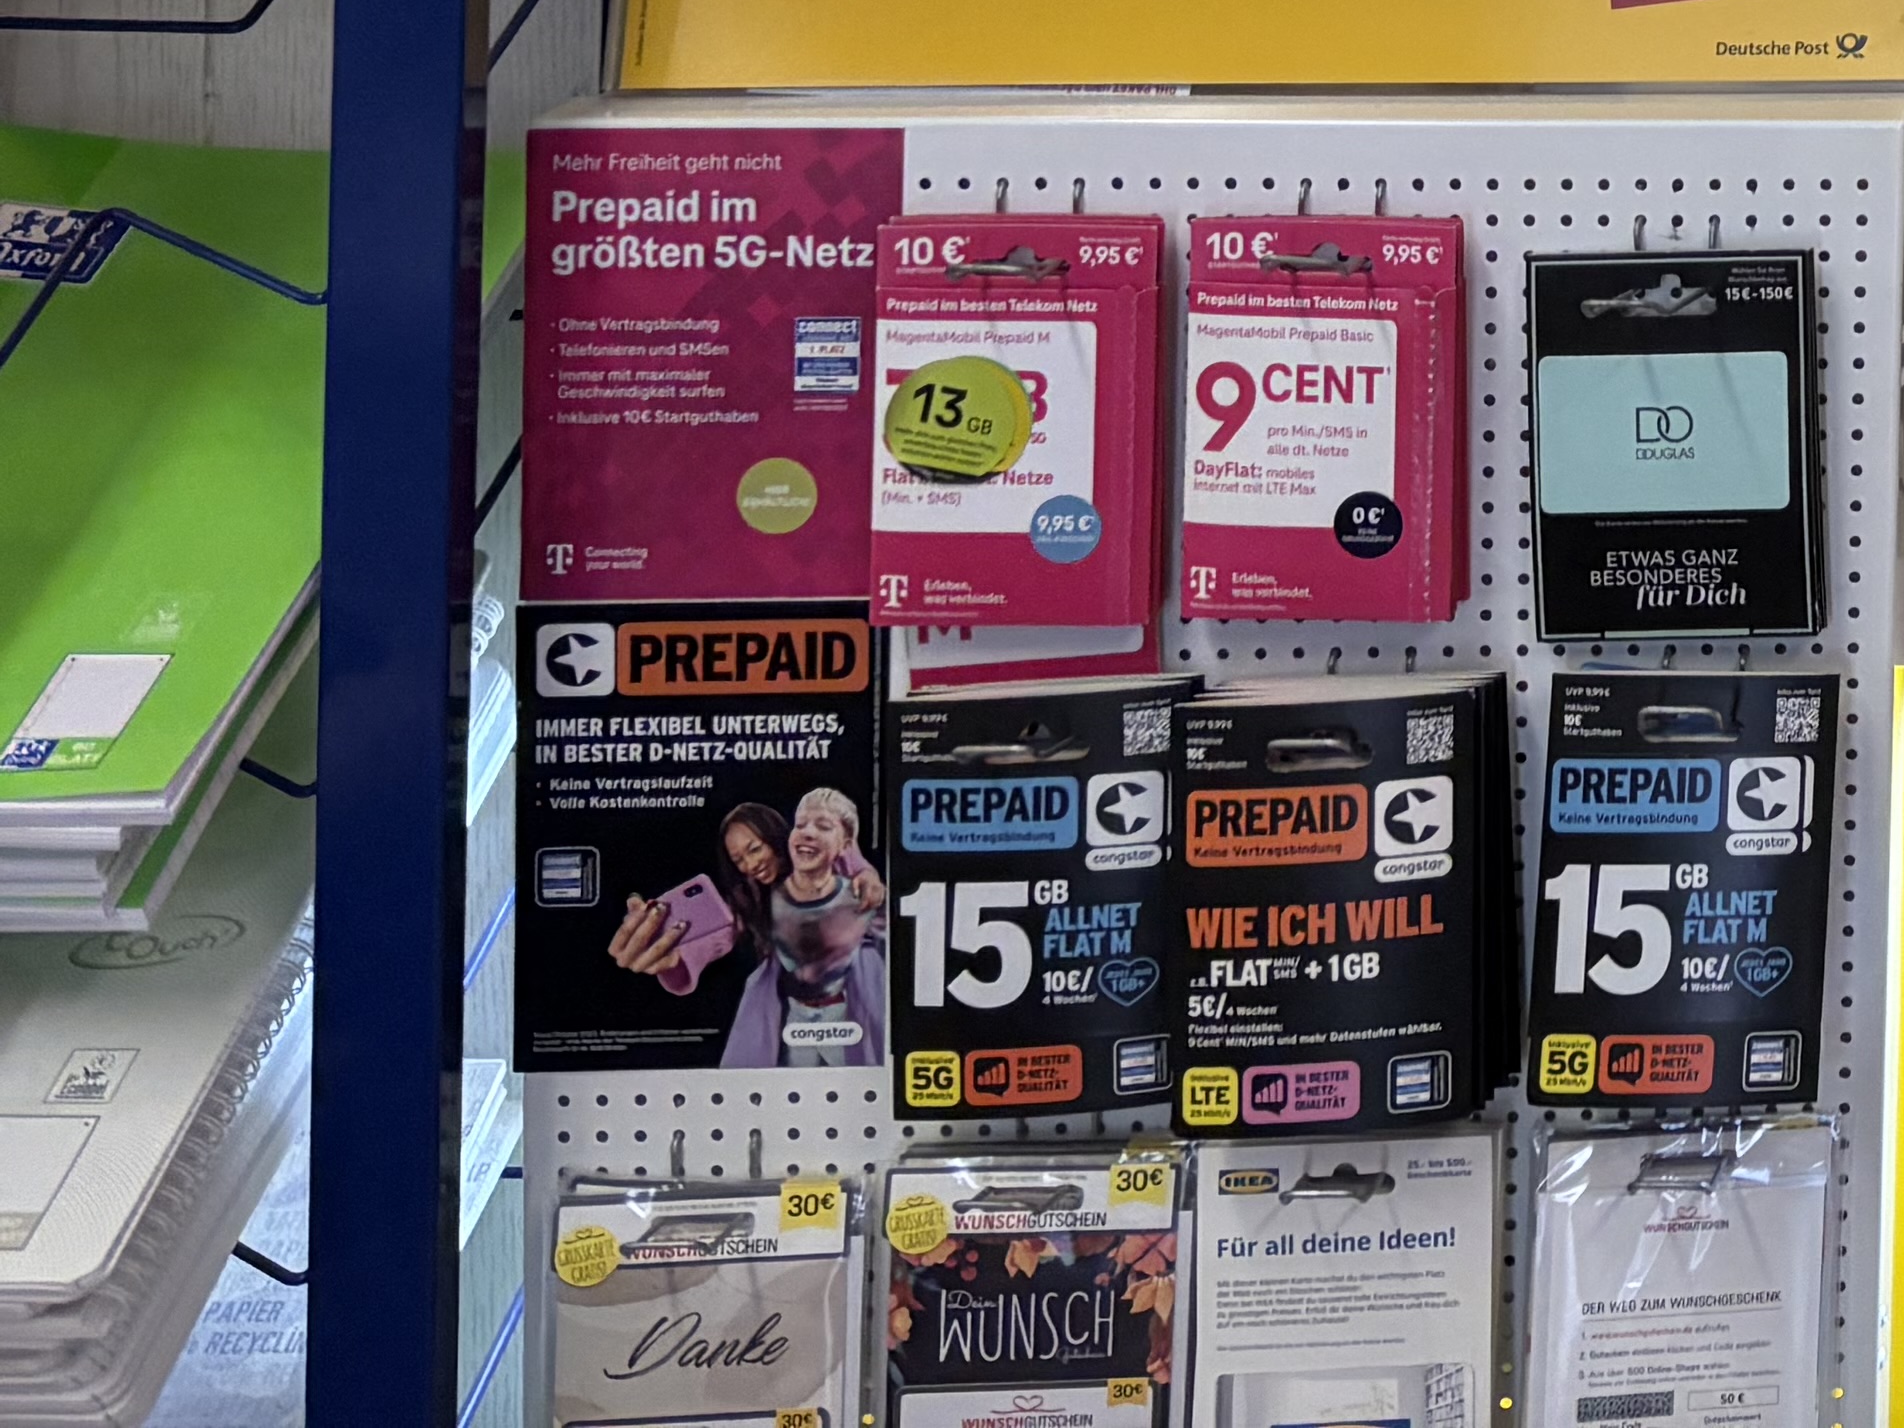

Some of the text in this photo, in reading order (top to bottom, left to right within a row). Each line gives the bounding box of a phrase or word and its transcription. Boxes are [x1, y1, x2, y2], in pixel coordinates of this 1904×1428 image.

[1716, 40, 1829, 57] Deutsche Post
[1606, 549, 1739, 566] ETWAS GANZ
[1590, 568, 1722, 586] BESONDERES
[1637, 583, 1746, 609] für Dich
[629, 629, 858, 683] PREPAID
[910, 787, 1069, 822] PREPAID
[1194, 795, 1358, 838] PREPAID
[1045, 903, 1141, 929] ALLNET
[1544, 864, 1672, 995] 15
[1043, 929, 1132, 957] FLAT M
[1116, 1168, 1163, 1192] 30€
[1223, 1173, 1274, 1189] IKEA
[787, 1193, 835, 1217] 30€
[956, 1212, 1107, 1229] WUNSCHGUTSCHEIN
[1216, 1228, 1455, 1258] Für all deine Ideen!
[202, 1300, 285, 1323] PAPIER
[939, 1289, 1115, 1364] WUNSCH
[604, 1312, 789, 1379] Danke
